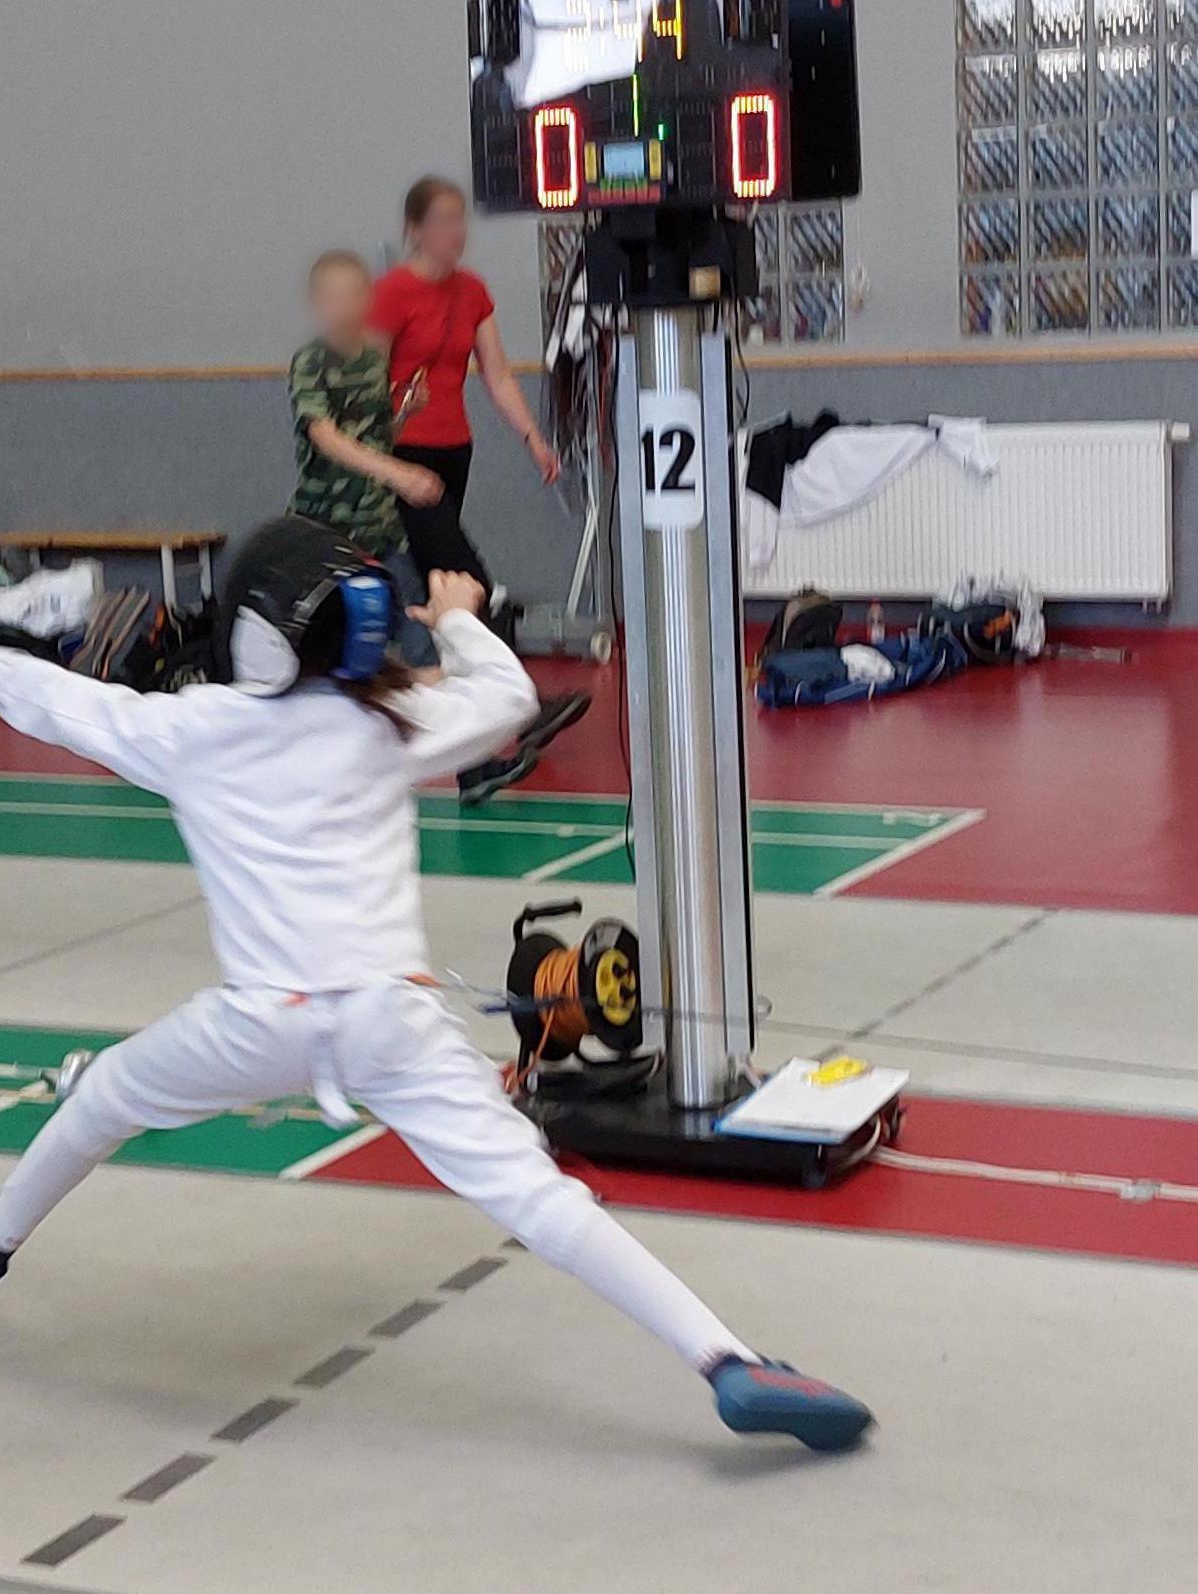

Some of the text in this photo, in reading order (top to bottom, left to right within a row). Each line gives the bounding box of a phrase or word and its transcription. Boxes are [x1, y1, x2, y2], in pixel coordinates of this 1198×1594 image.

[534, 107, 579, 209] 0
[730, 94, 776, 199] 0
[642, 426, 696, 493] 12
